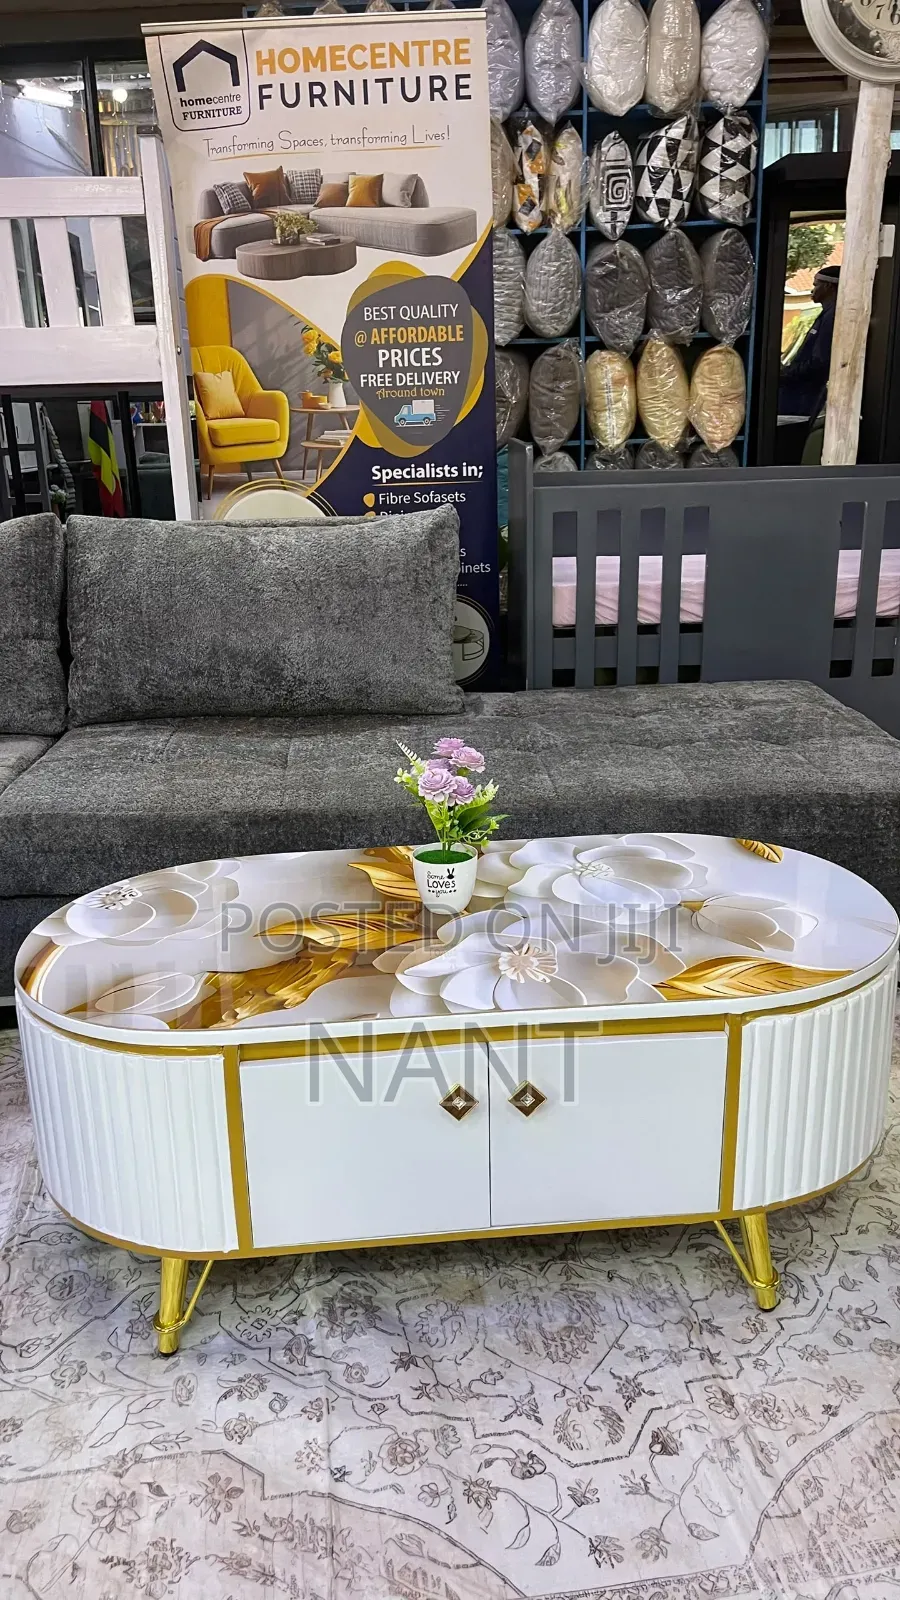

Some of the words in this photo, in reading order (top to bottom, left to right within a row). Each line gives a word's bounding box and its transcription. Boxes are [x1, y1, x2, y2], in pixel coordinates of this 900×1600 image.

[255, 38, 472, 76] HOMECENTRE
[179, 93, 242, 107] homecentre
[257, 73, 473, 111] FURNITURE
[182, 106, 243, 121] FURNITURE
[202, 134, 275, 158] Transforming
[278, 130, 328, 151] Spaces,
[330, 126, 408, 148] transforming
[411, 124, 451, 144] Lives!
[363, 306, 397, 321] BEST
[399, 303, 459, 320] QUALITY
[354, 330, 368, 348] @
[370, 324, 465, 345] AFFORDABLE
[377, 347, 443, 368] PRICES
[360, 373, 393, 388] FREE
[396, 370, 461, 387] DELIVERY
[376, 387, 418, 400] Around
[420, 386, 446, 397] town
[371, 463, 459, 483] Specialists
[462, 462, 484, 478] in;
[379, 492, 411, 505] Fibre
[413, 490, 467, 504] Sofasets
[459, 562, 492, 574] inets
[426, 879, 456, 889] Loves
